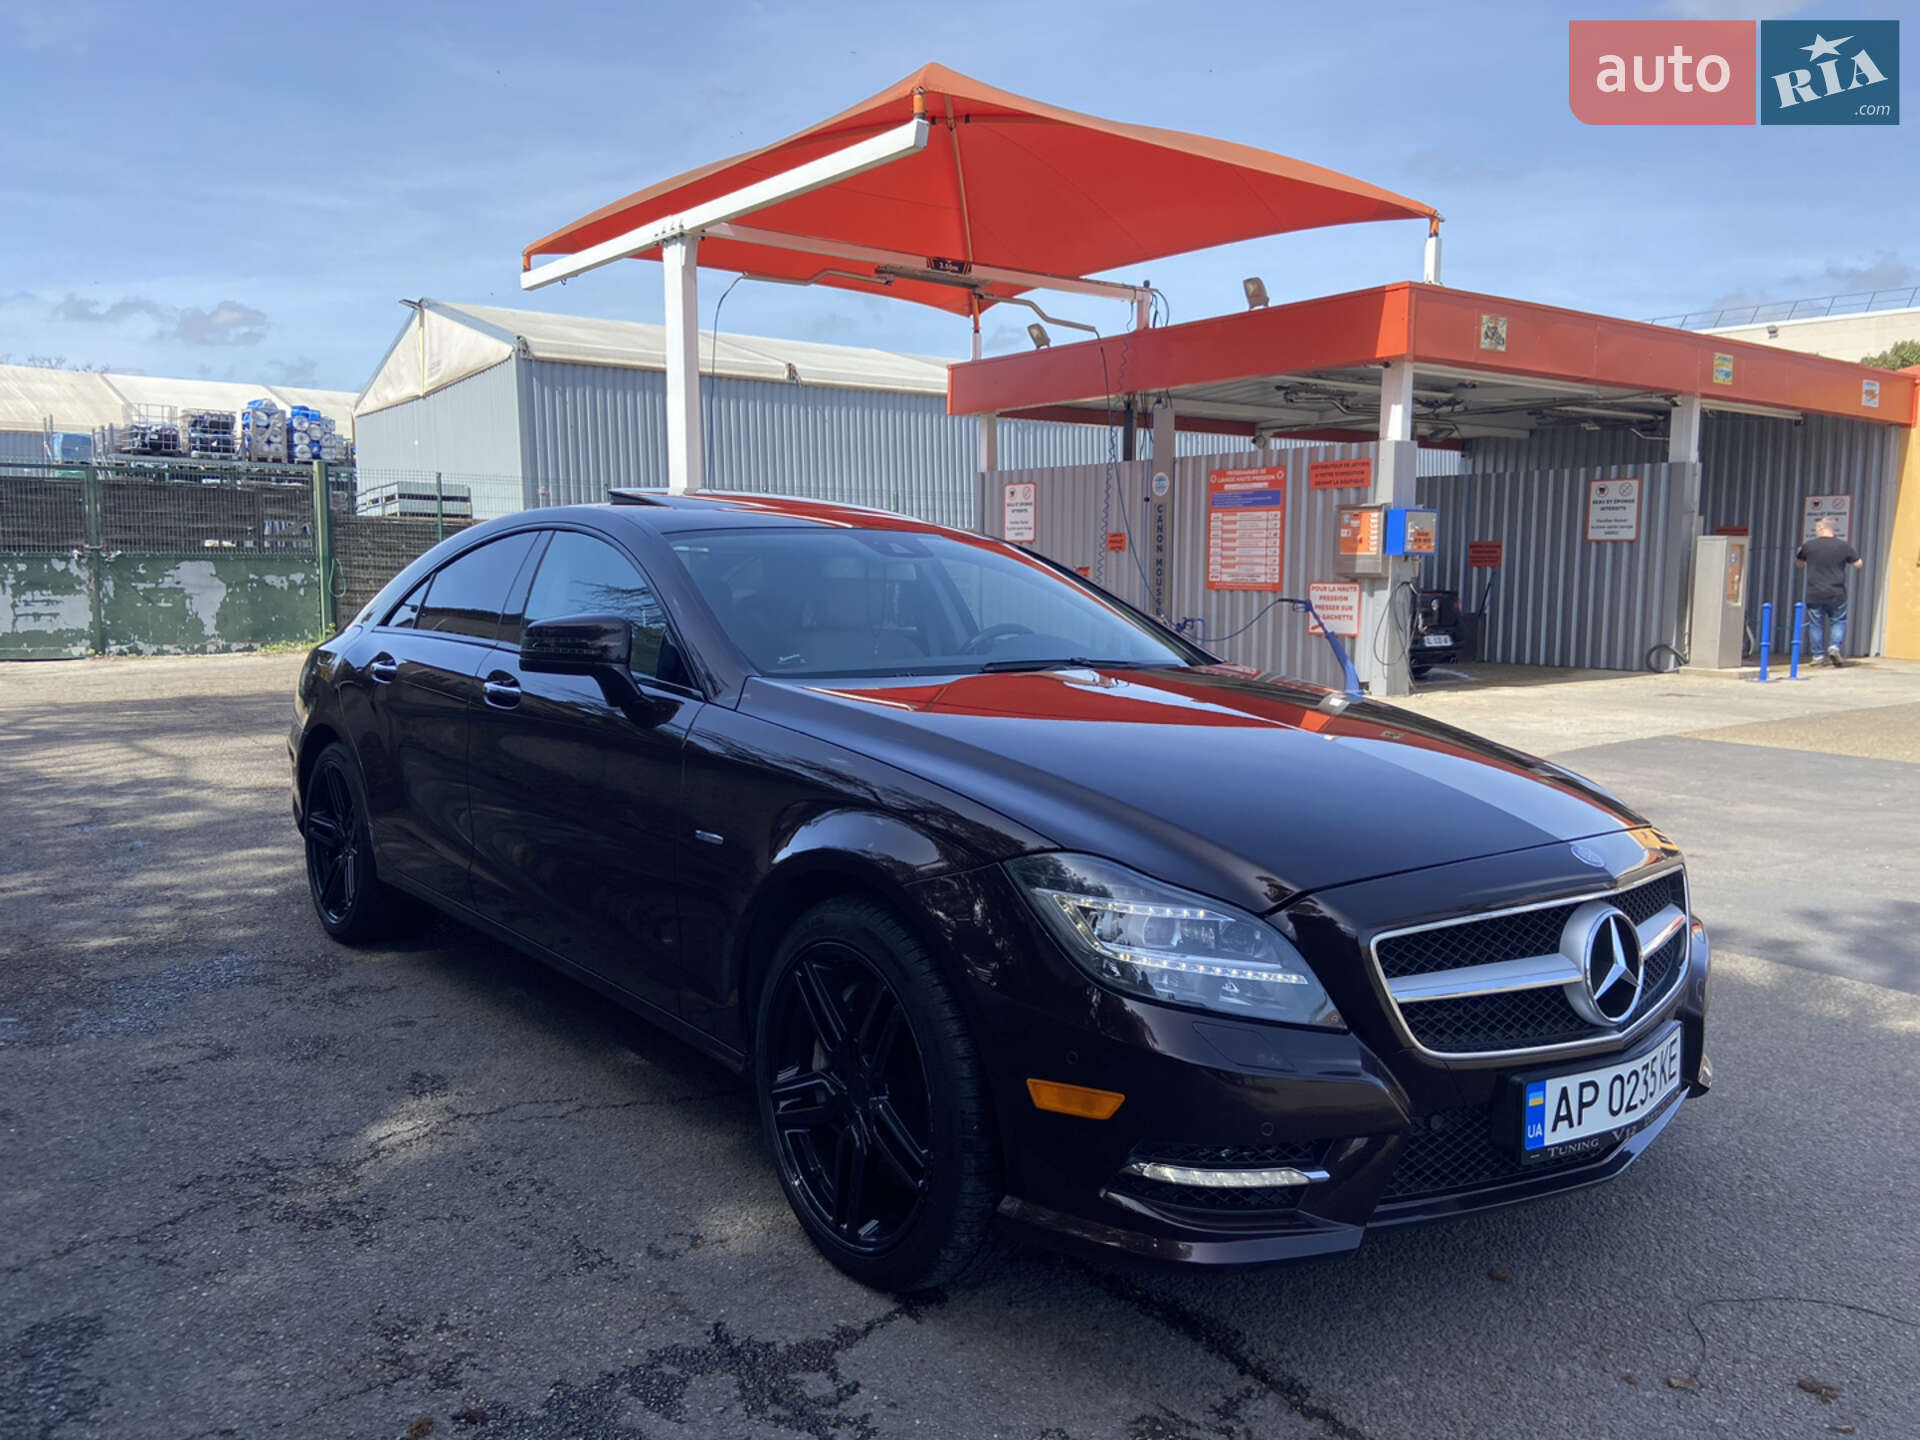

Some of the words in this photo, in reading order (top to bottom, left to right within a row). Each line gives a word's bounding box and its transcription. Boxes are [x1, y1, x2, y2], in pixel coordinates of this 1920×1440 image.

[1156, 504, 1164, 552] CANON
[1551, 1079, 1600, 1132] AP
[1608, 1055, 1657, 1117] 0235
[1659, 1038, 1678, 1091] KE
[1527, 1123, 1543, 1139] UA
[1547, 1138, 1599, 1158] TUNING
